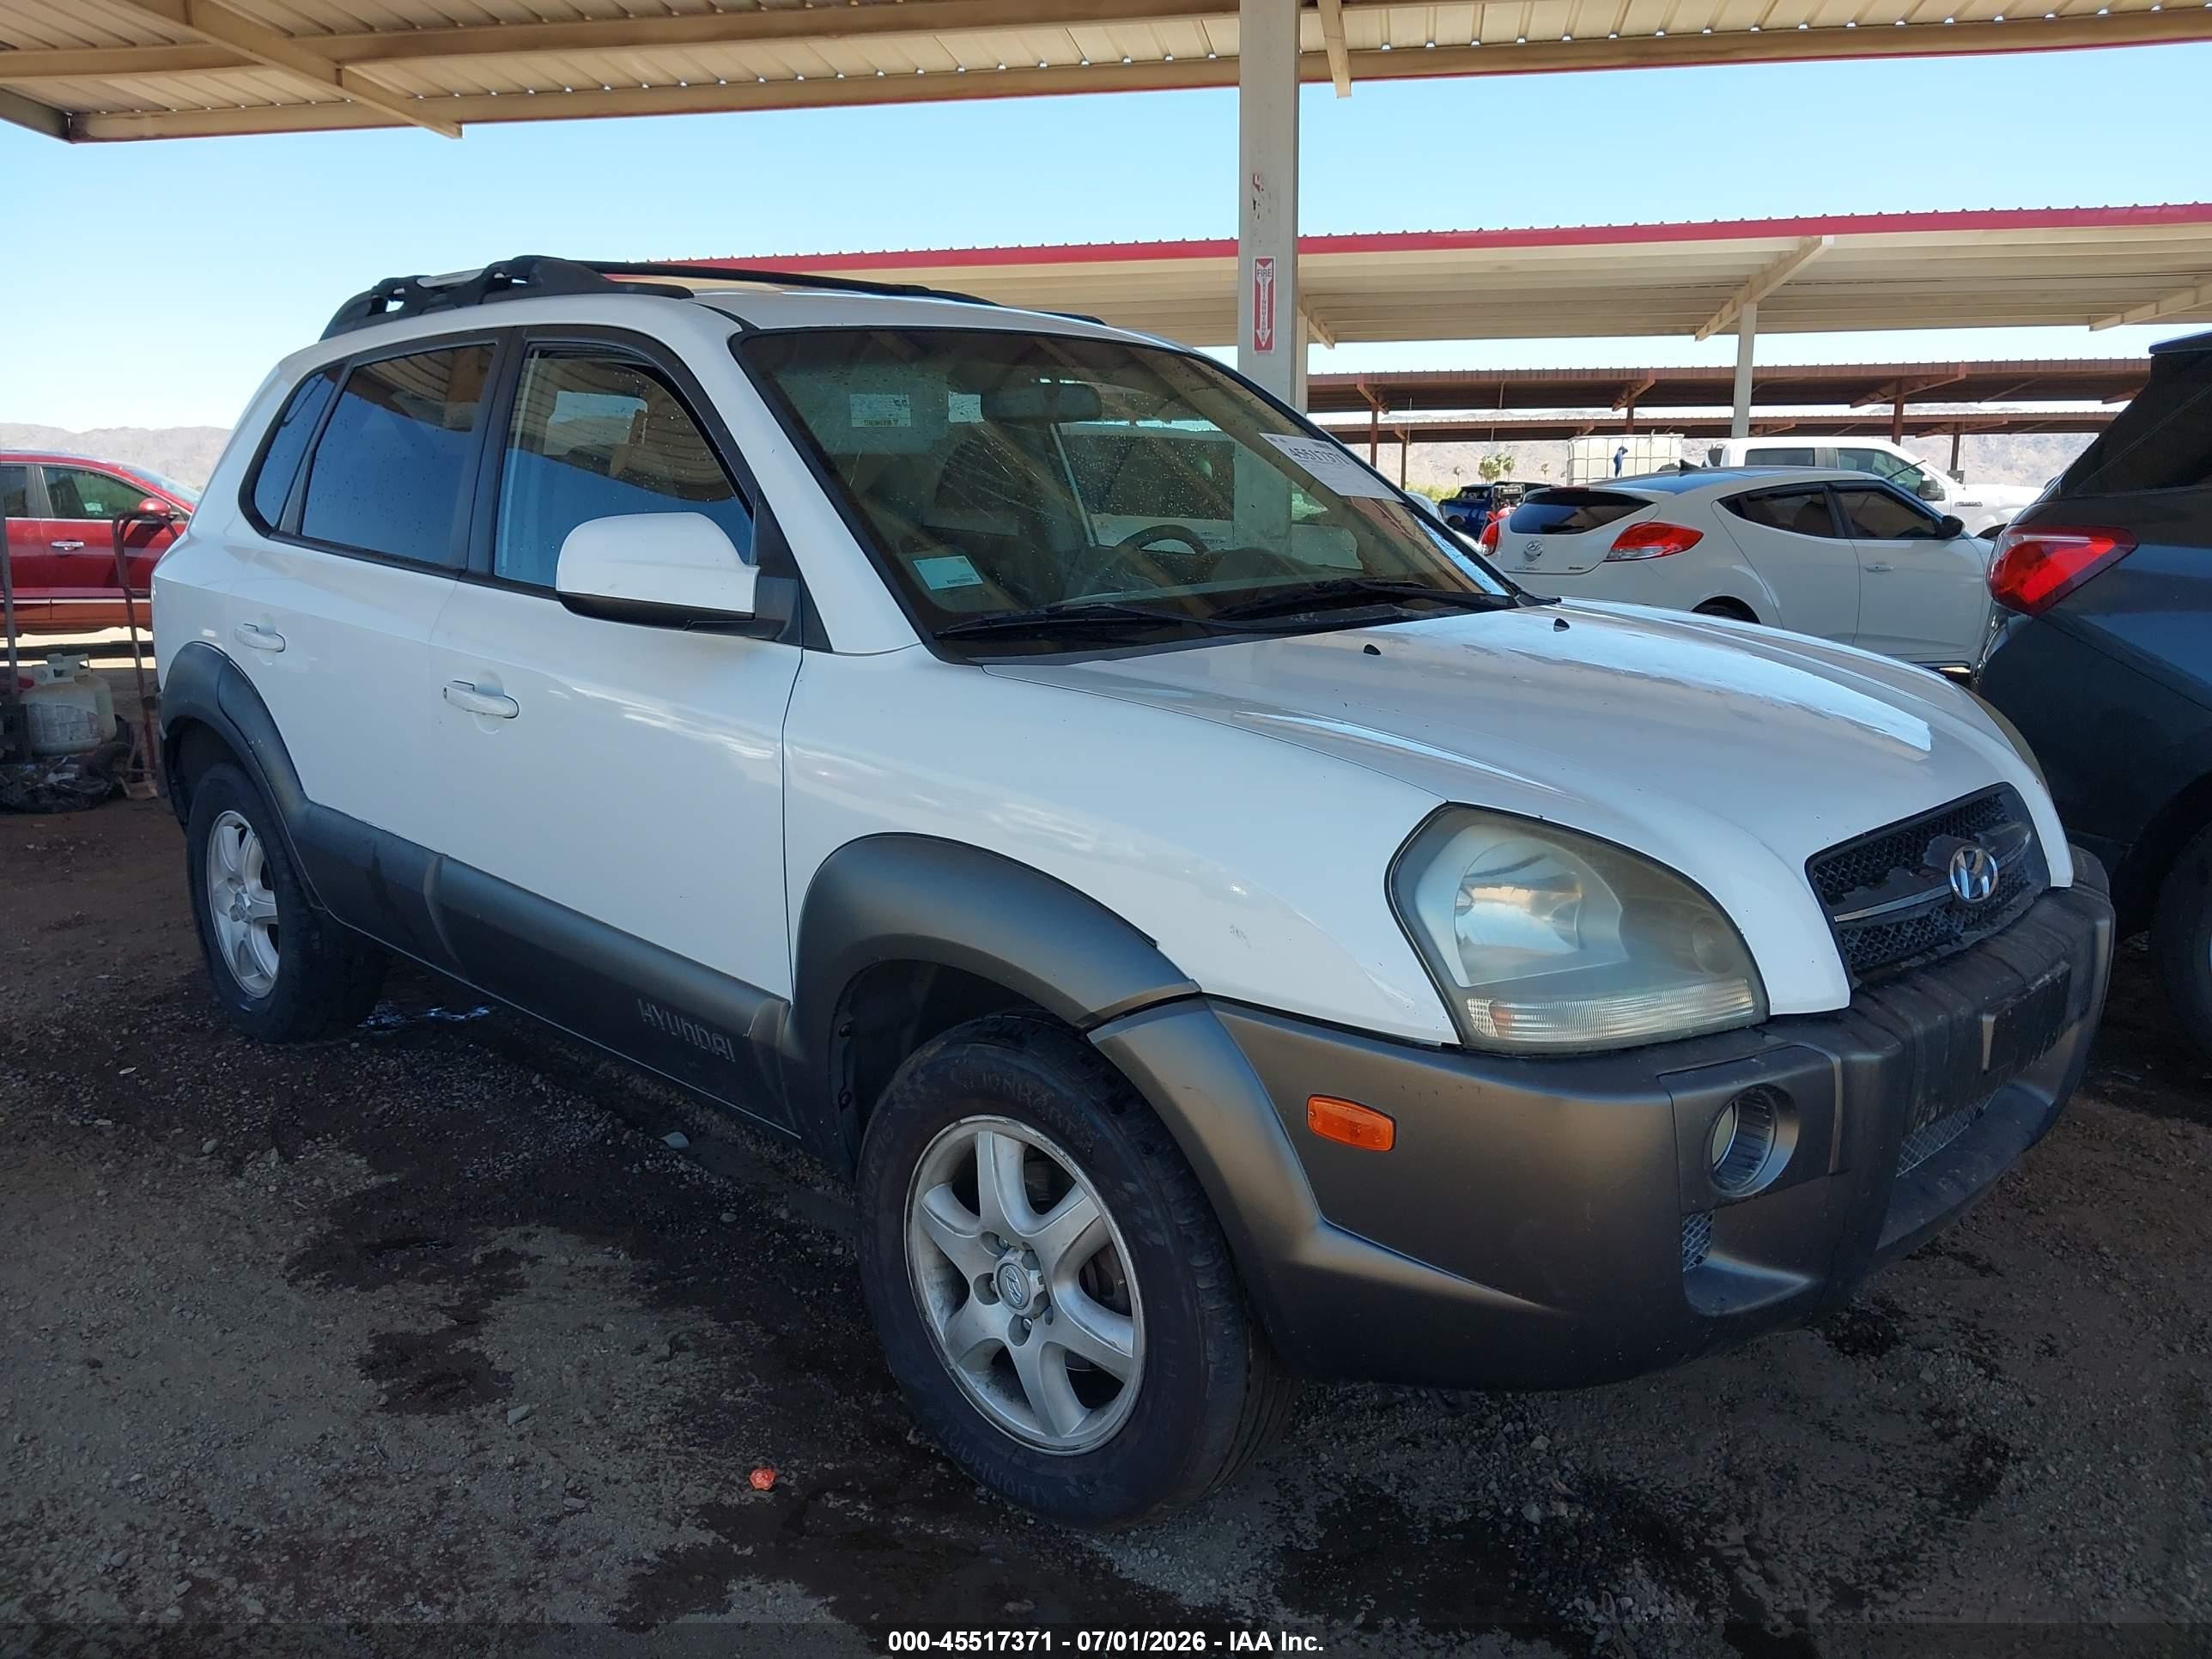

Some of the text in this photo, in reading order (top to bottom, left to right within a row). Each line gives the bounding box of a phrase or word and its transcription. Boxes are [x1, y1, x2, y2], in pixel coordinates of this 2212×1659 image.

[1257, 269, 1272, 277] FIRE
[1287, 447, 1351, 465] 45517371
[638, 999, 736, 1062] HYUNDAI
